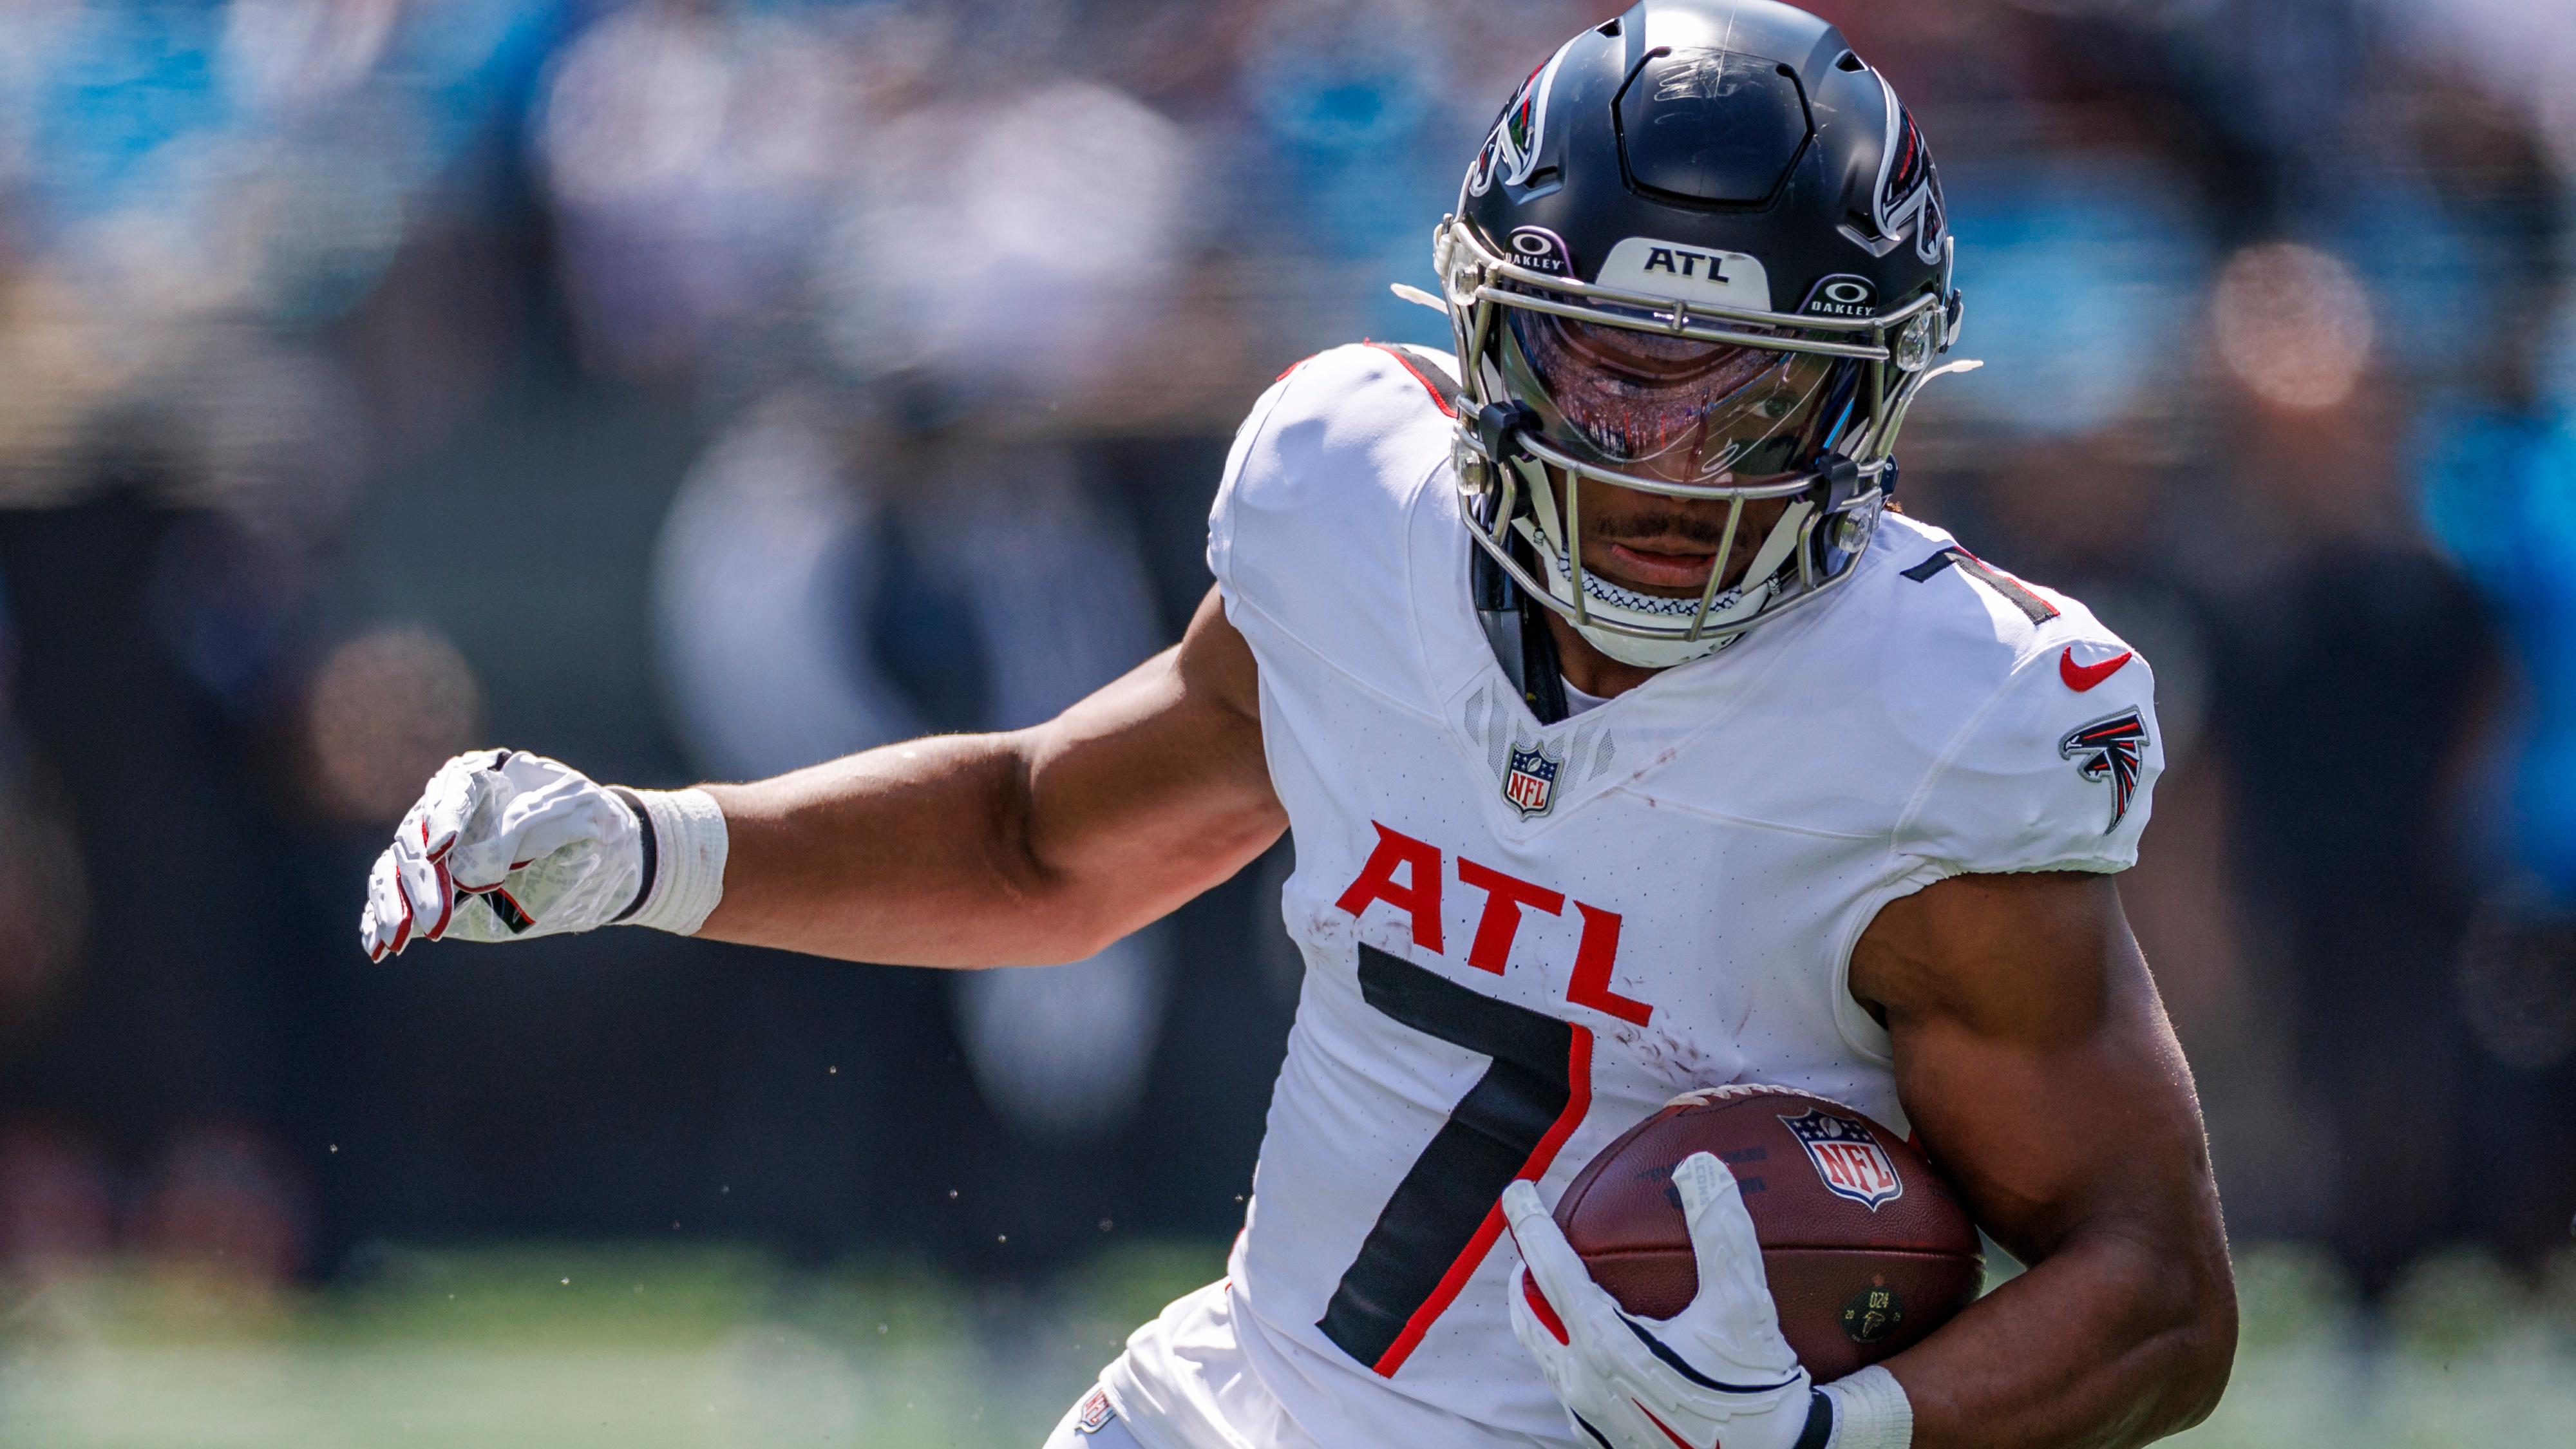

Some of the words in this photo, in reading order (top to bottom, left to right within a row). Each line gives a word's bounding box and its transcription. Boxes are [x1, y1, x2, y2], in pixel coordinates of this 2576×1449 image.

[1505, 252, 1560, 270] OAKLEY
[1644, 247, 1729, 283] ATL
[1811, 301, 1873, 316] OAKLEY
[1508, 772, 1544, 807] NFL
[1335, 819, 1653, 1028] ATL
[1314, 940, 1594, 1379] 7
[1813, 1143, 1894, 1193] NFL
[1870, 1291, 1889, 1308] 024
